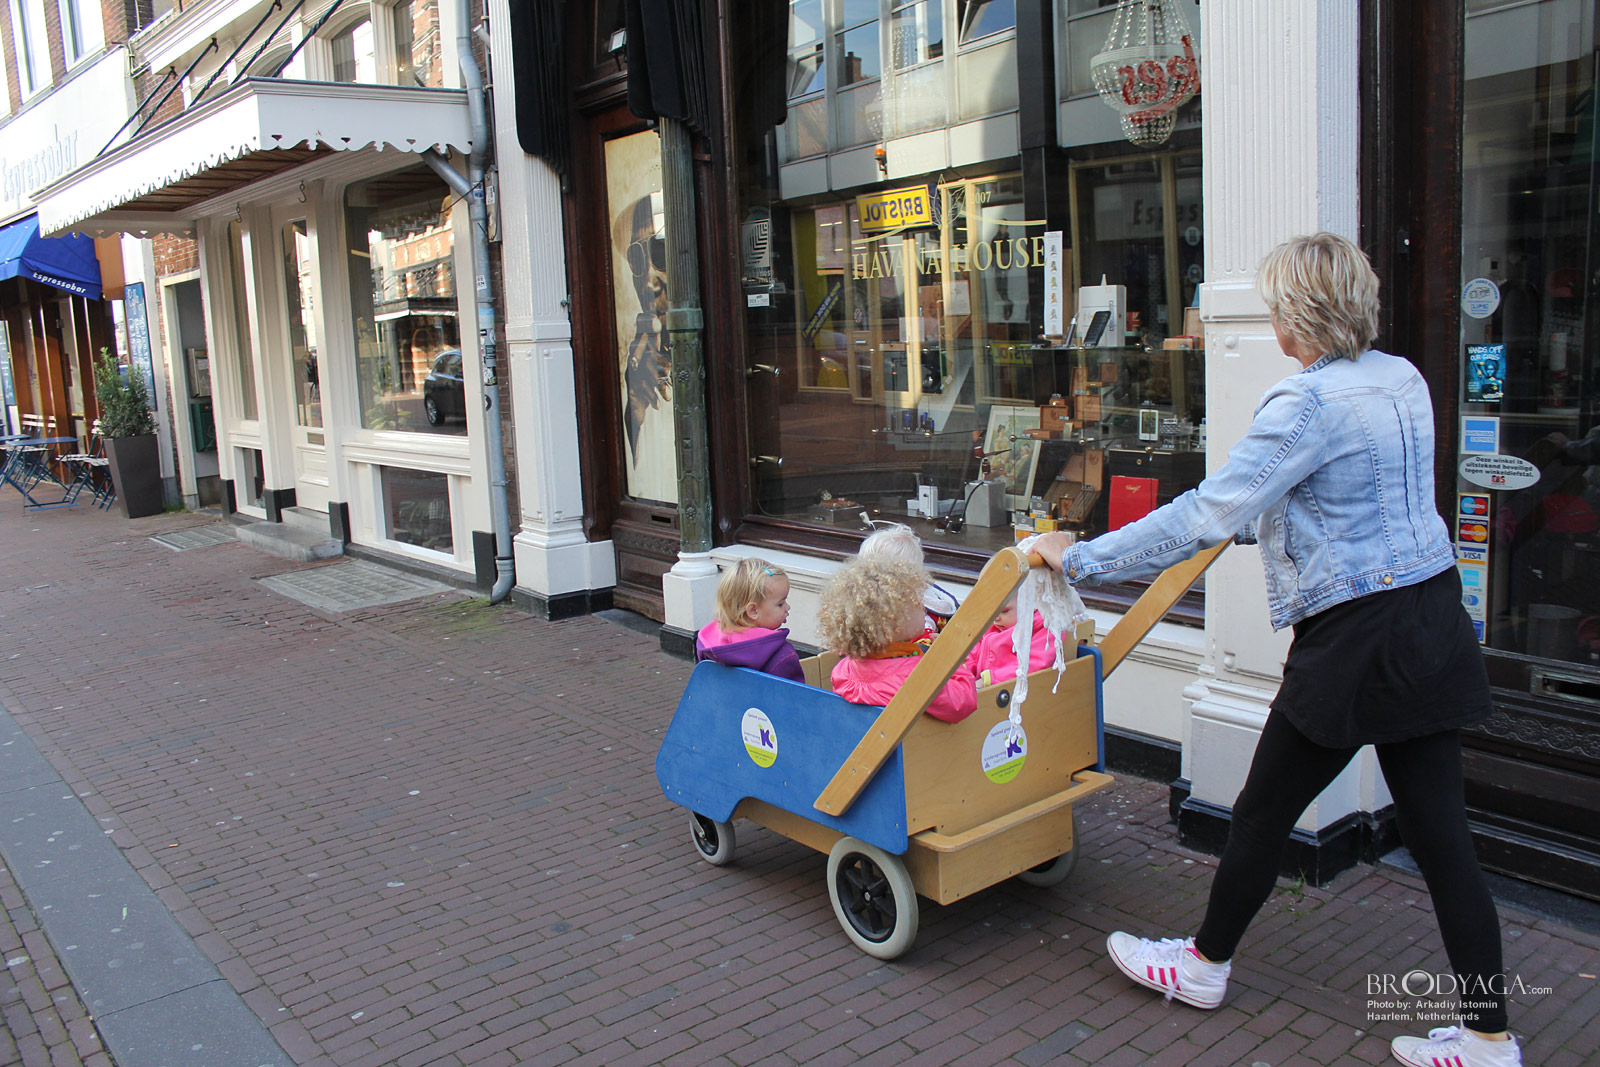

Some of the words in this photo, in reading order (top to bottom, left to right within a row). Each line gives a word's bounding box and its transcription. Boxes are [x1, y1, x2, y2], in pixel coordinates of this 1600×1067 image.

[3, 123, 78, 209] Espressobar
[851, 247, 942, 280] HAVANA
[951, 236, 1047, 273] HOUSE
[33, 272, 86, 293] Espressobar
[1468, 346, 1487, 354] HANDS
[1489, 345, 1504, 353] OFF
[1466, 461, 1500, 469] uitstekend
[1503, 464, 1533, 472] beveiligd
[1463, 552, 1482, 560] VISA
